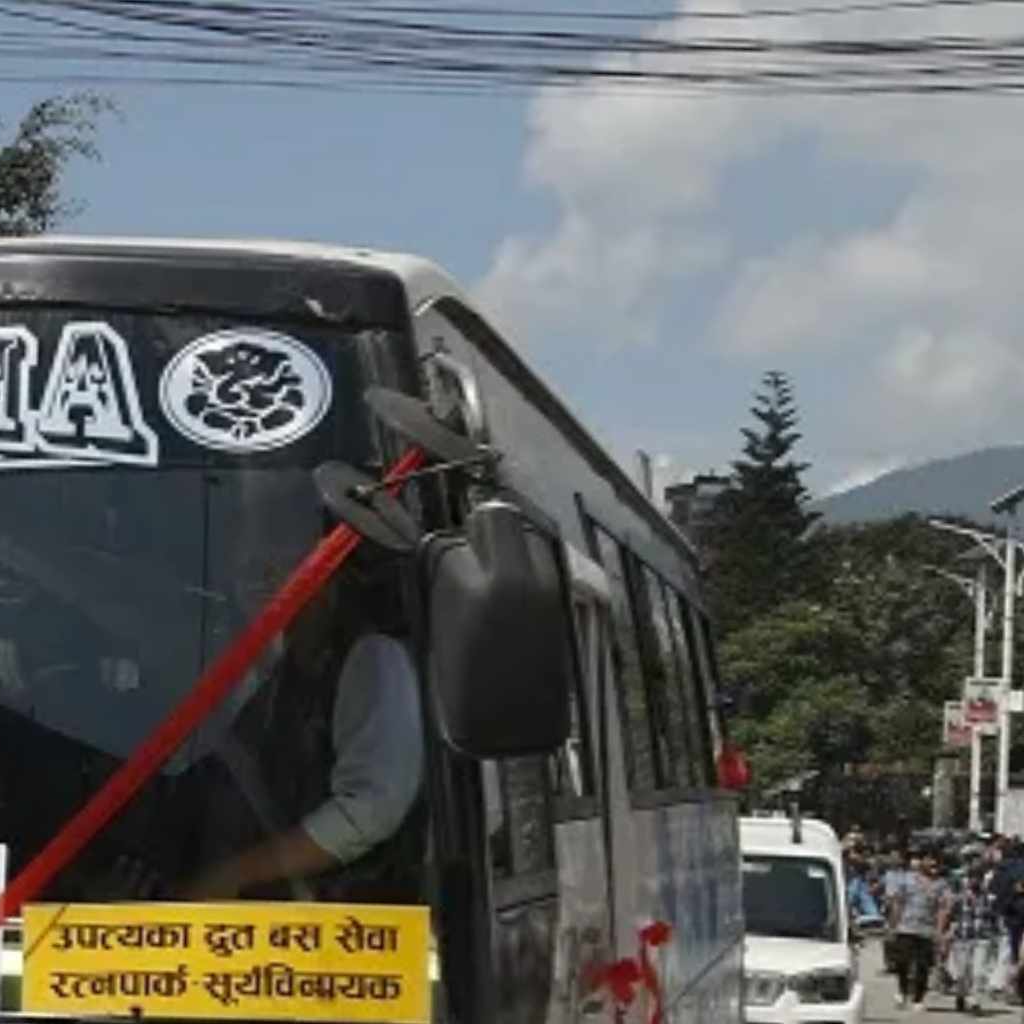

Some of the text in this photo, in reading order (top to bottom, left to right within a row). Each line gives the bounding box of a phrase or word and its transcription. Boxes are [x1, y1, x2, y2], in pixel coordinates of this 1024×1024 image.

[52, 922, 193, 951] उपत्यका
[269, 922, 323, 952] बस
[334, 915, 400, 953] सेवा
